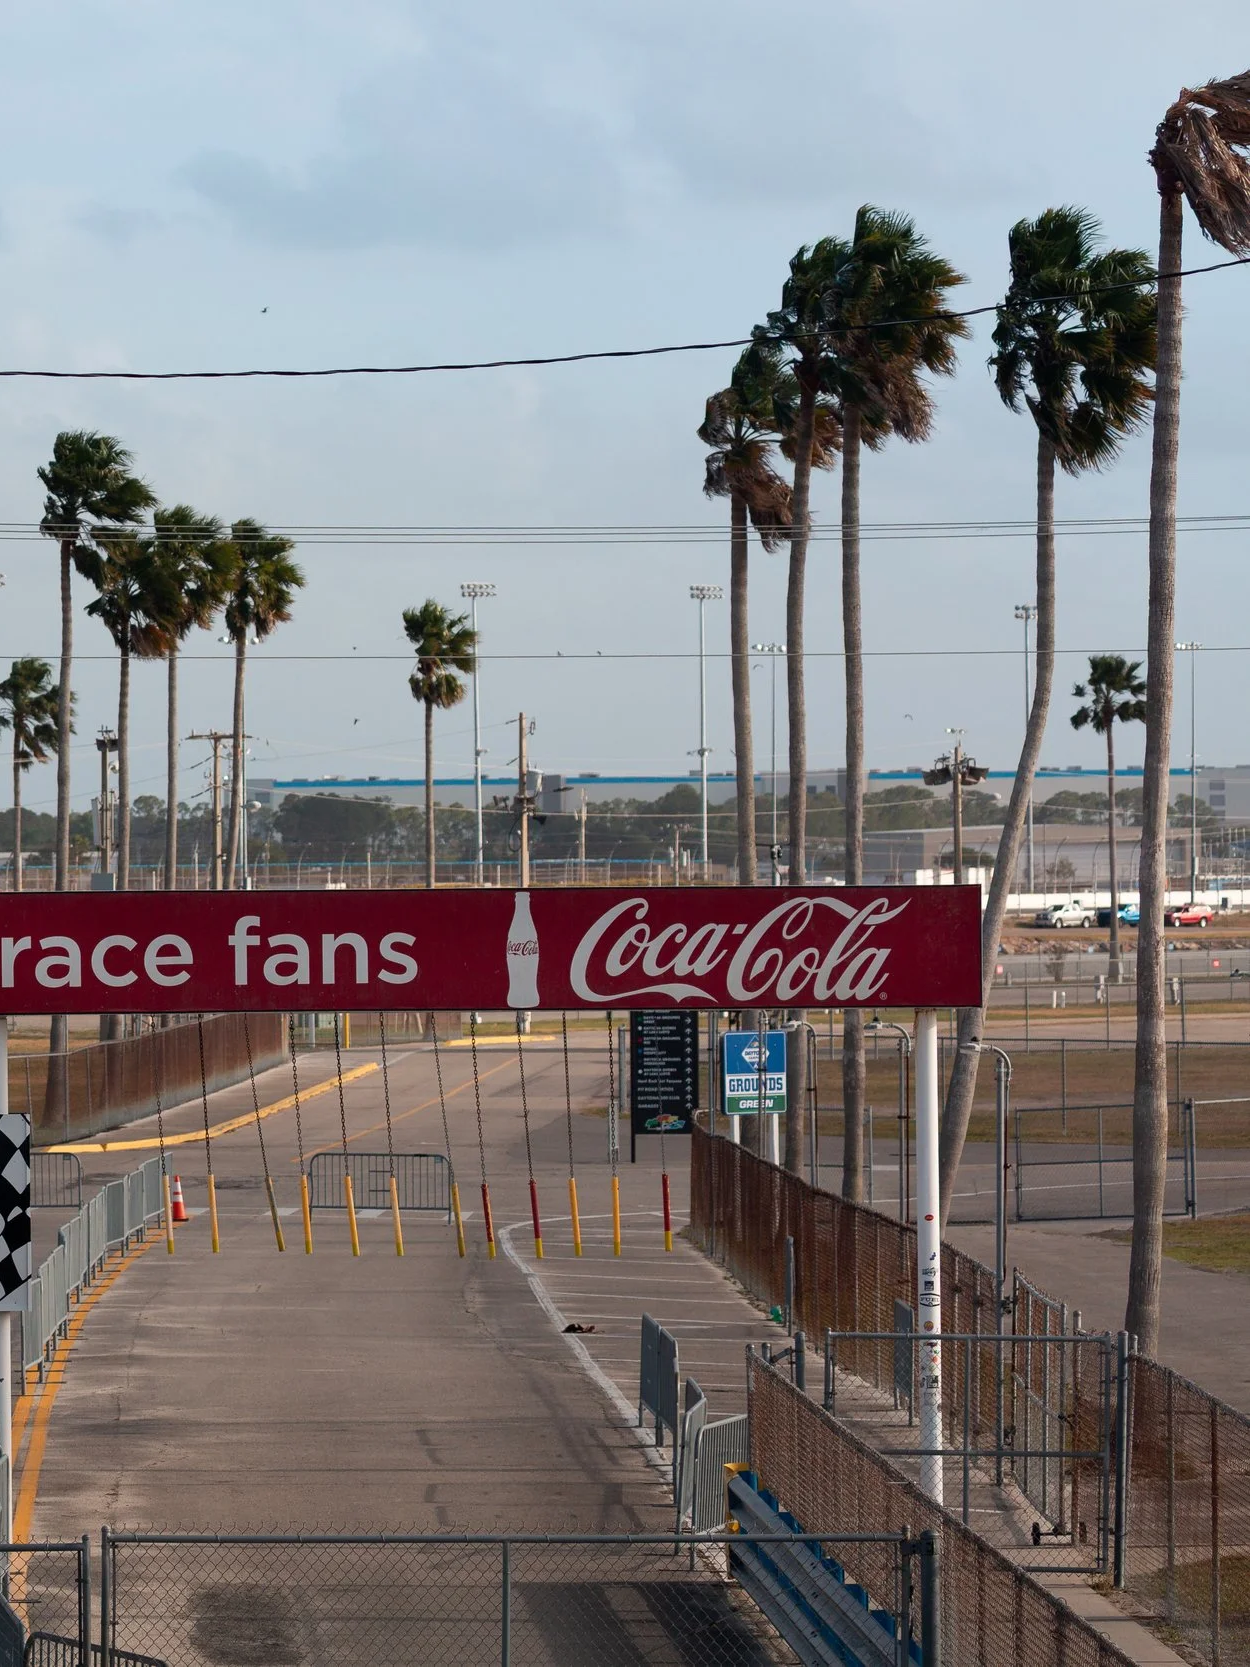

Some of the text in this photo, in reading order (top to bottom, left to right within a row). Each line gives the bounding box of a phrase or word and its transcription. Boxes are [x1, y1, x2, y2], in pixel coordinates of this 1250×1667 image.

[1, 934, 194, 988] race
[228, 915, 419, 986] fans
[570, 897, 912, 1003] Coca-Cola
